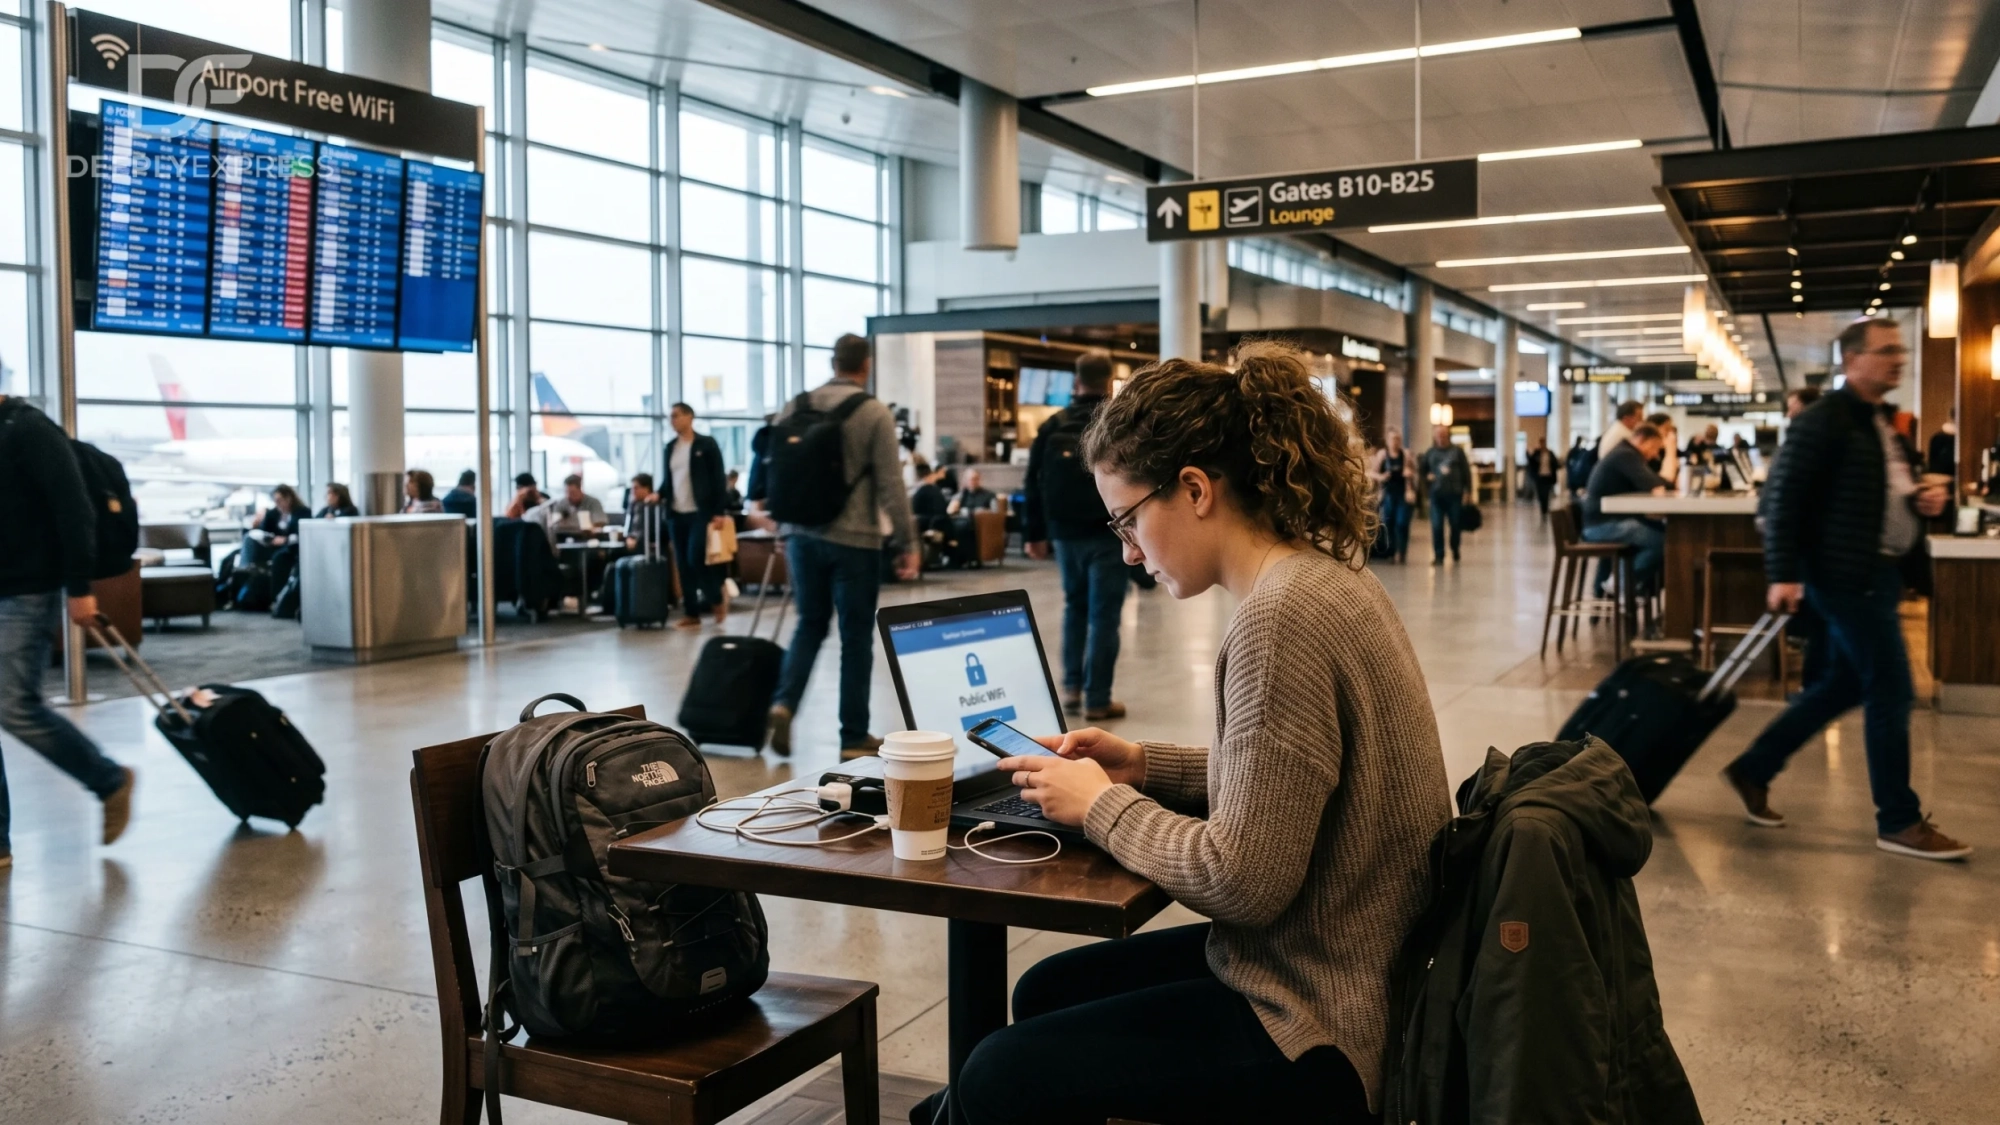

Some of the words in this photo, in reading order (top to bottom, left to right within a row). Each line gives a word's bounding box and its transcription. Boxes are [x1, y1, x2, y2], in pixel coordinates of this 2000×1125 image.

[200, 59, 289, 102] Airport
[294, 79, 344, 114] Free
[348, 91, 395, 125] WiFi
[1269, 181, 1333, 204] Gates
[1338, 170, 1435, 198] B10-B25
[1269, 206, 1334, 226] Lounge
[958, 691, 987, 707] Public
